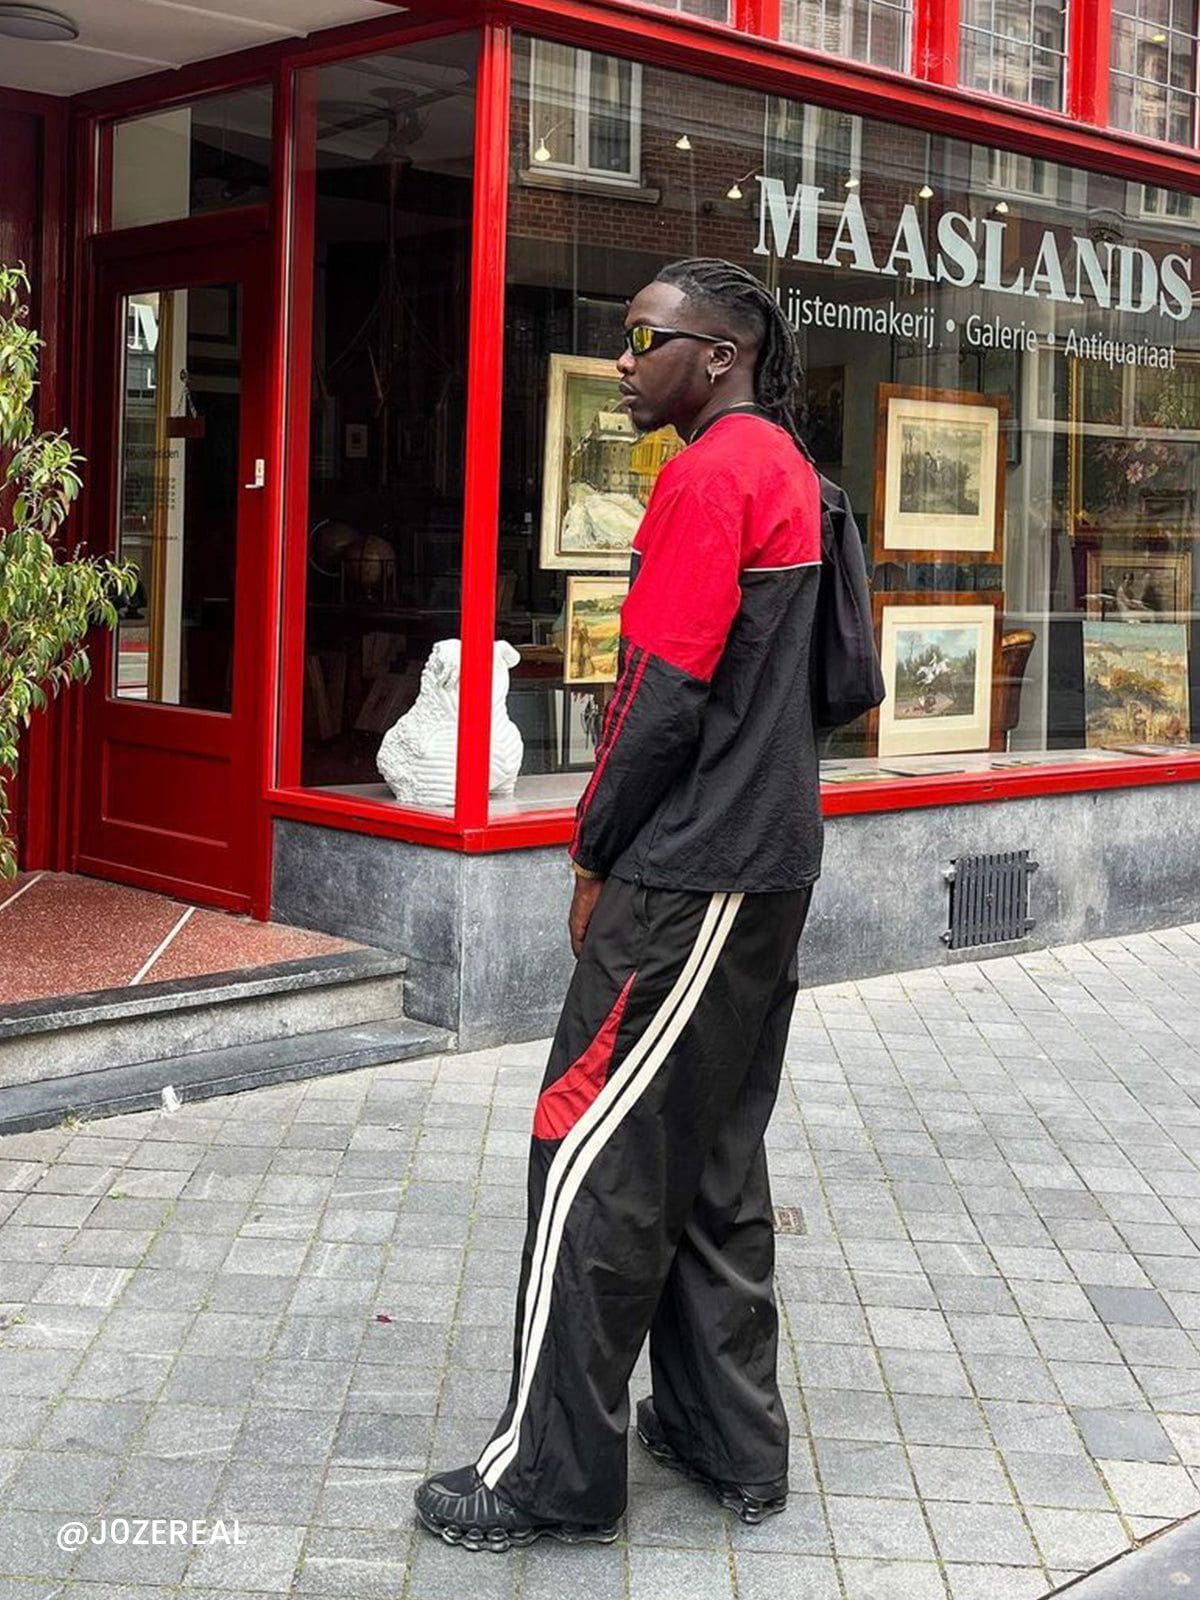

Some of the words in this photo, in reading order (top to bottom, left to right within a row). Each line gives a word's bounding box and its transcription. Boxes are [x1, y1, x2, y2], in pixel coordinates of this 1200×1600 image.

[753, 175, 1193, 322] MAASLANDS
[966, 314, 1038, 352] Galerie
[1064, 328, 1176, 370] Antiquariaat
